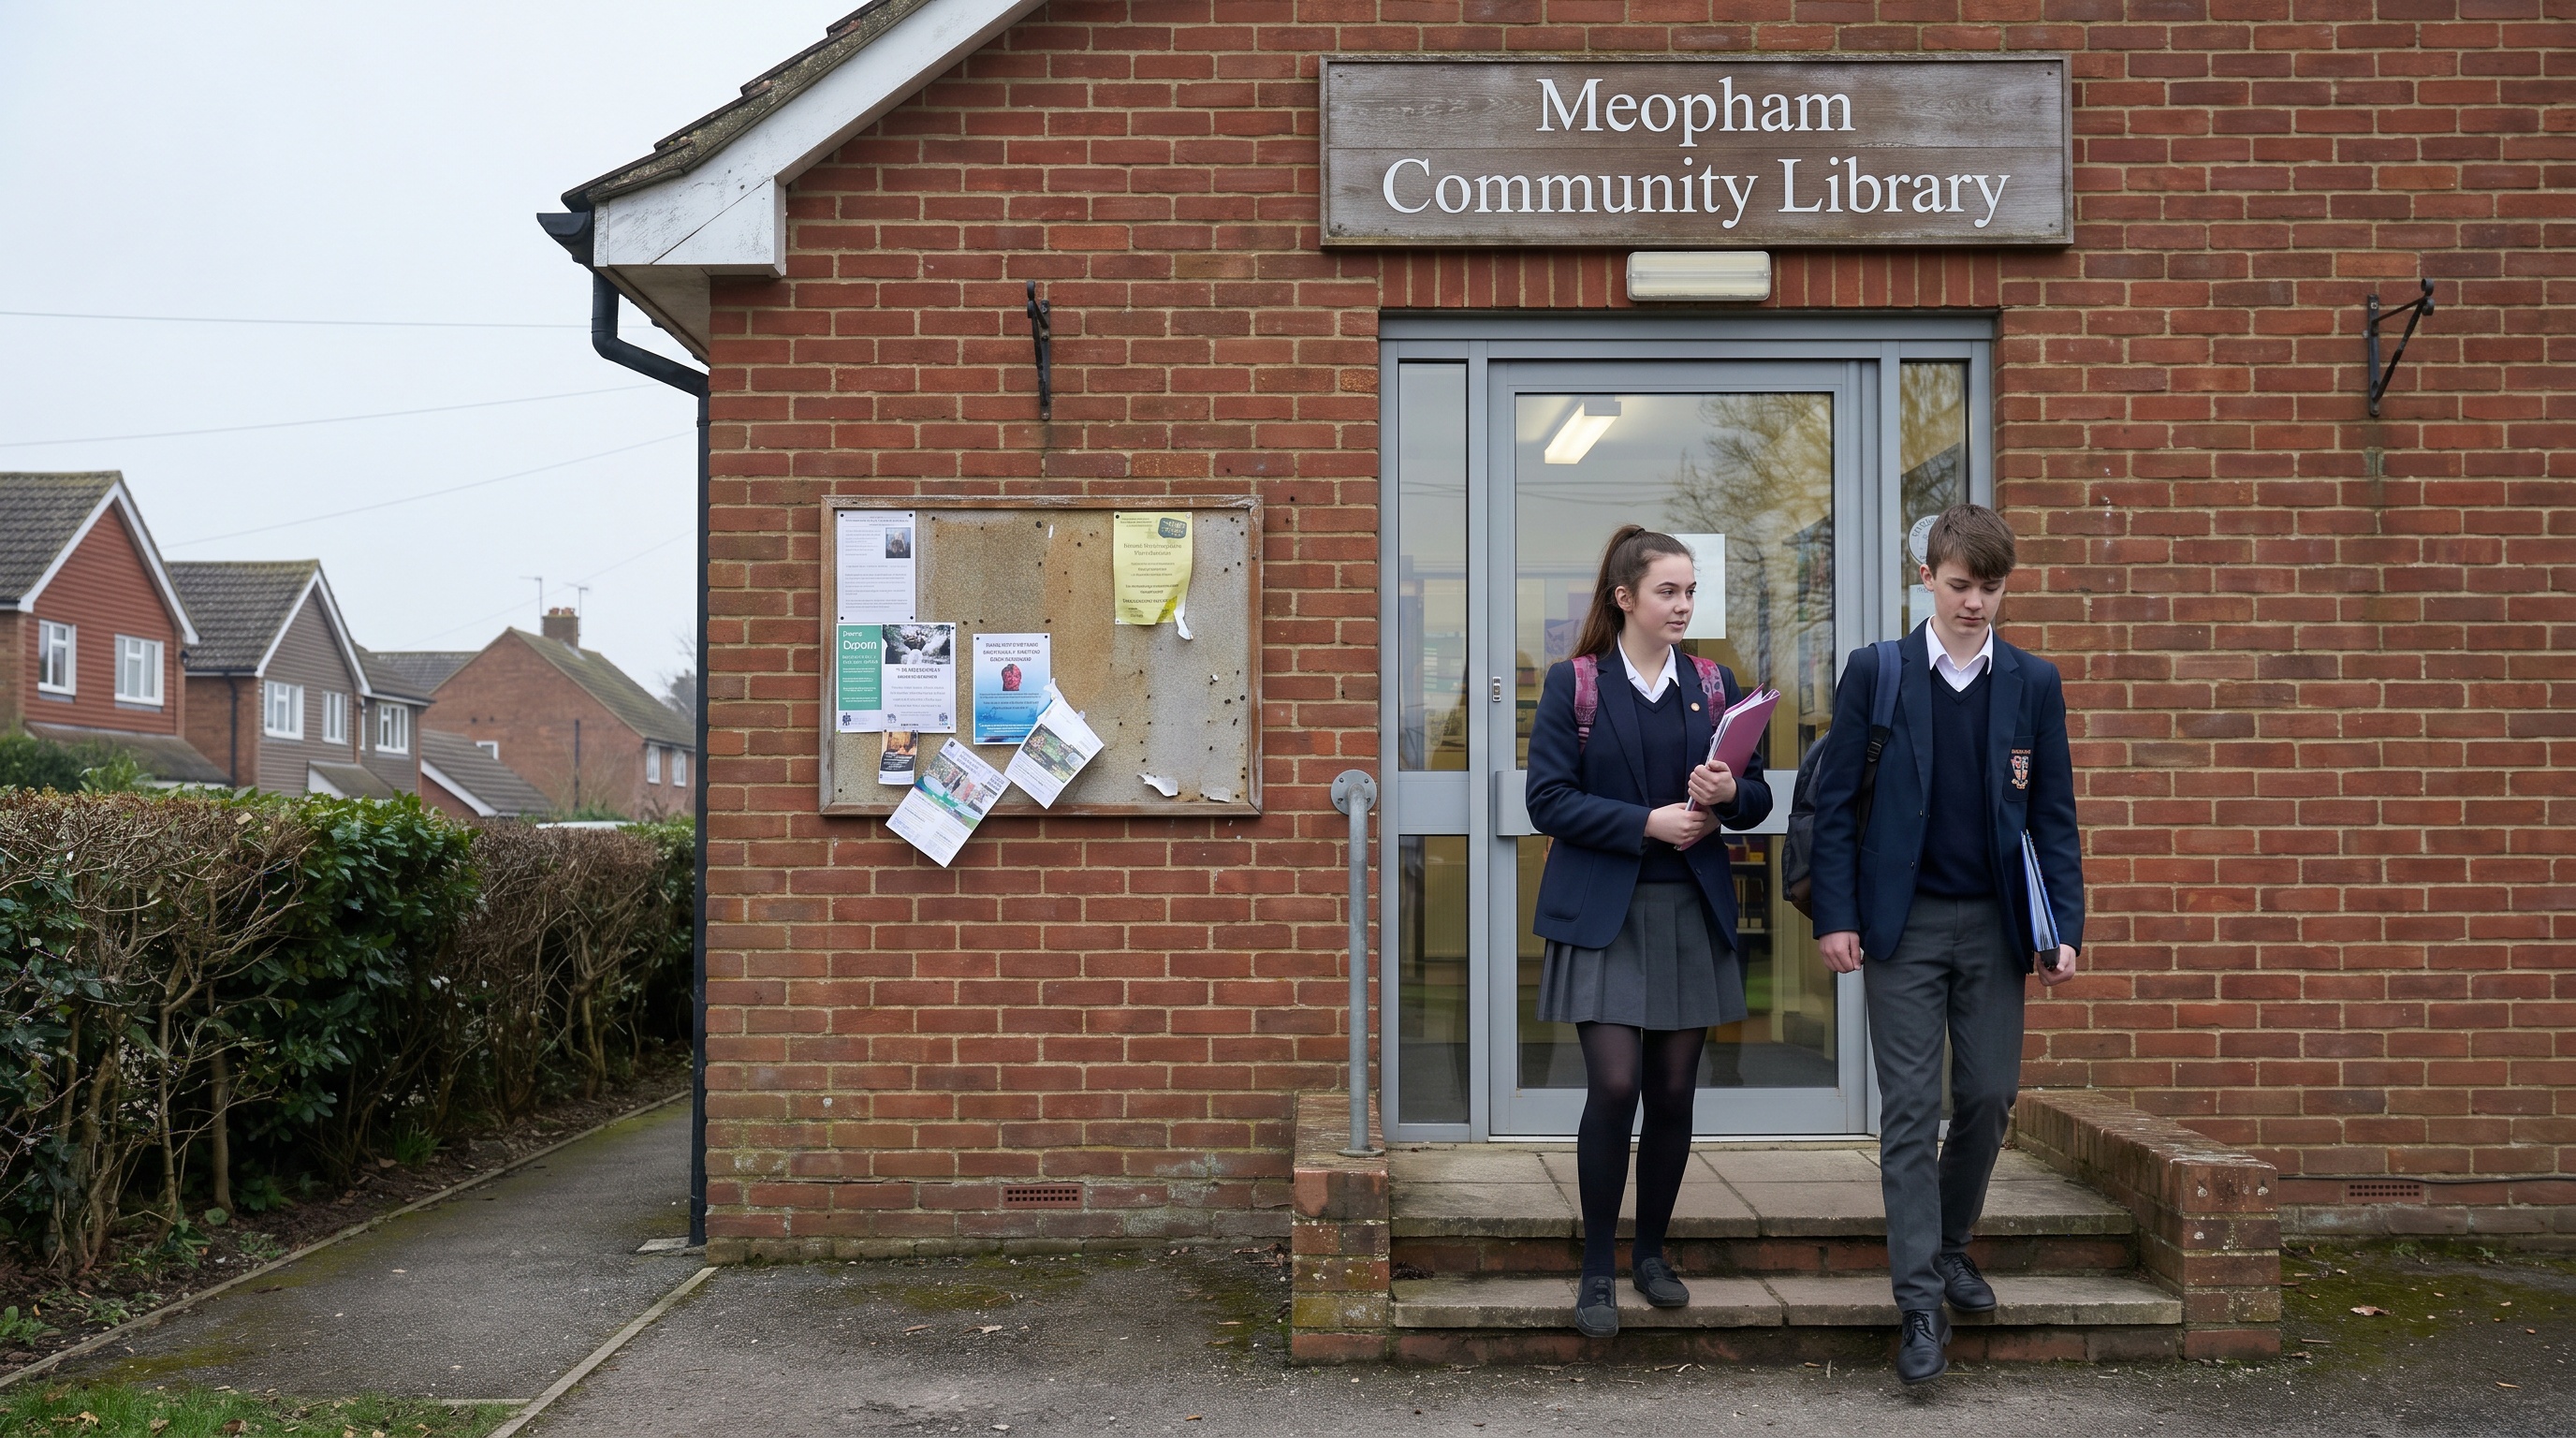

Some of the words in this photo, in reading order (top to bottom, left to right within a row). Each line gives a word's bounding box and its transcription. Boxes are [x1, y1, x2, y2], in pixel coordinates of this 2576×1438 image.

[1536, 77, 1855, 147] Meopham
[1383, 157, 1758, 228] Community
[1778, 156, 2011, 228] Library
